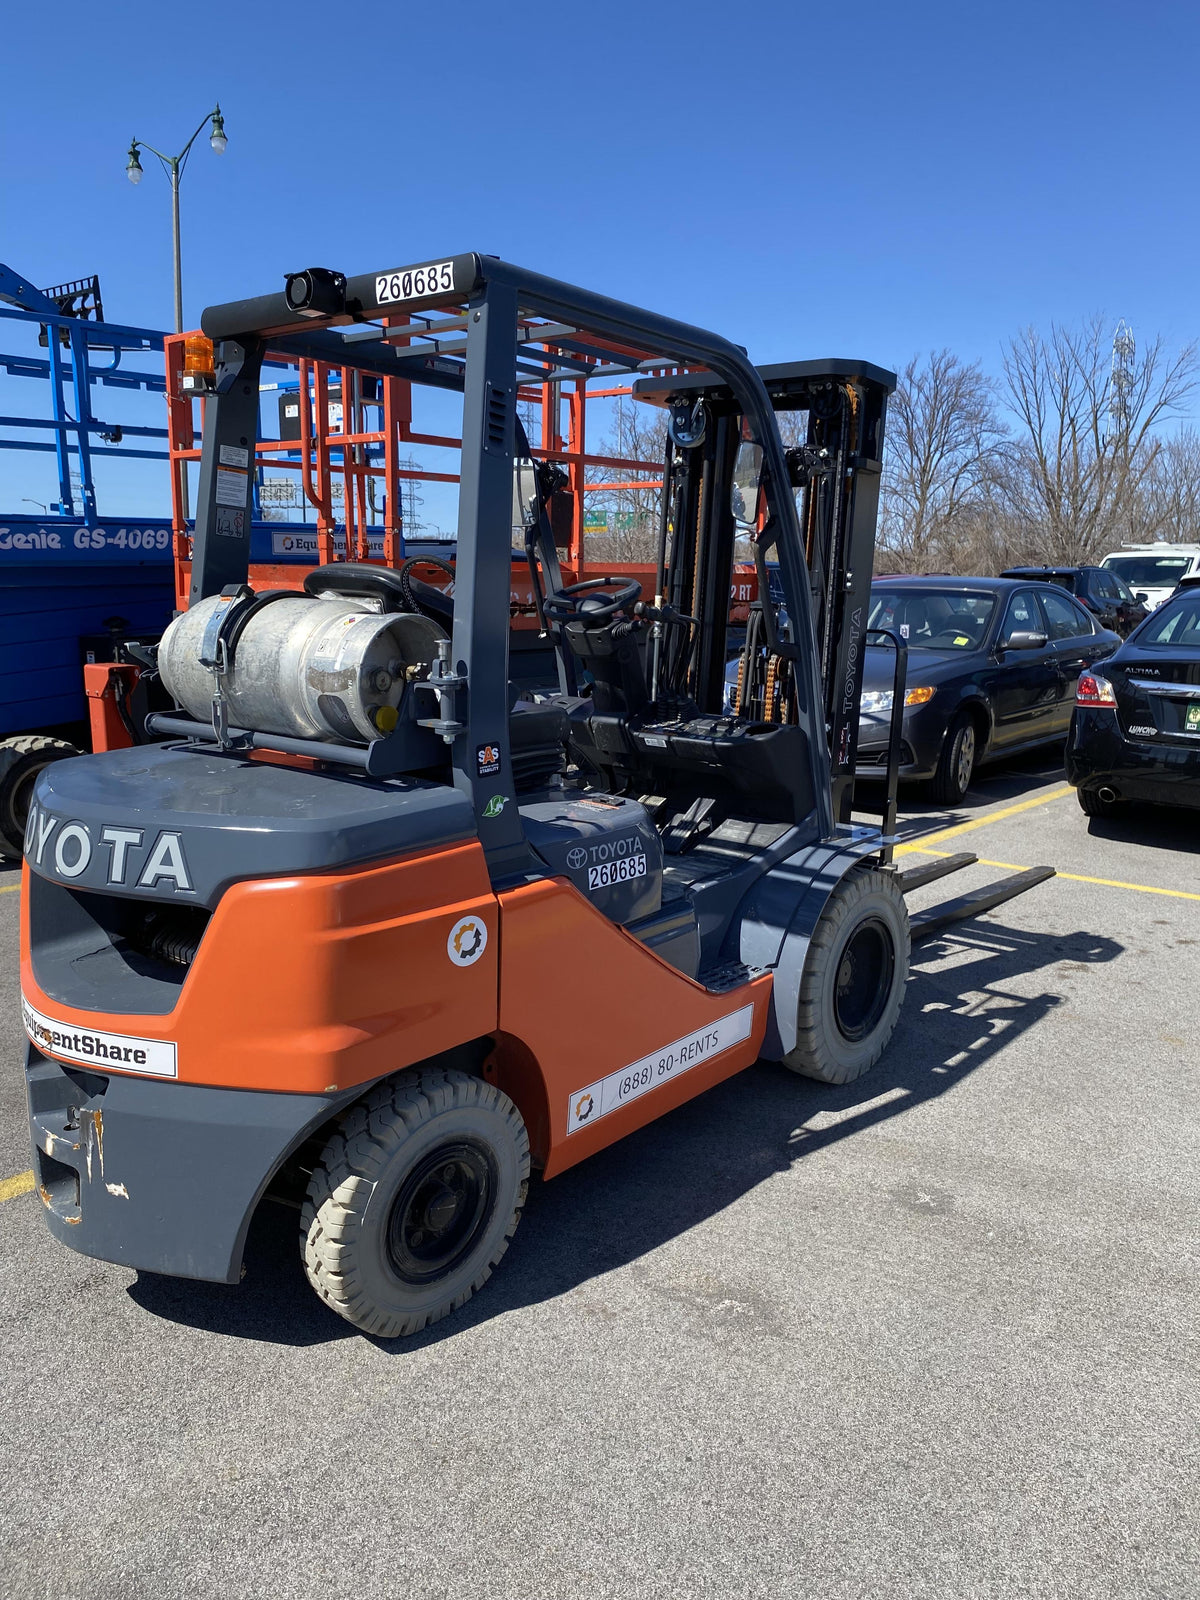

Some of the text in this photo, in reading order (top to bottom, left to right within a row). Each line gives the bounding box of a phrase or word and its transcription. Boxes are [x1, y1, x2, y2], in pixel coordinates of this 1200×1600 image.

[377, 263, 452, 302] 260685
[0, 528, 170, 550] Genie GS-4069
[739, 584, 752, 601] RT
[843, 607, 862, 715] TOYOTA
[1124, 667, 1161, 676] ALTIMA
[478, 746, 499, 764] SAS
[24, 805, 191, 891] OYOTA
[589, 836, 643, 863] TOYOTA
[590, 855, 646, 889] 260685
[617, 1030, 719, 1100] (888) 80-RENTS
